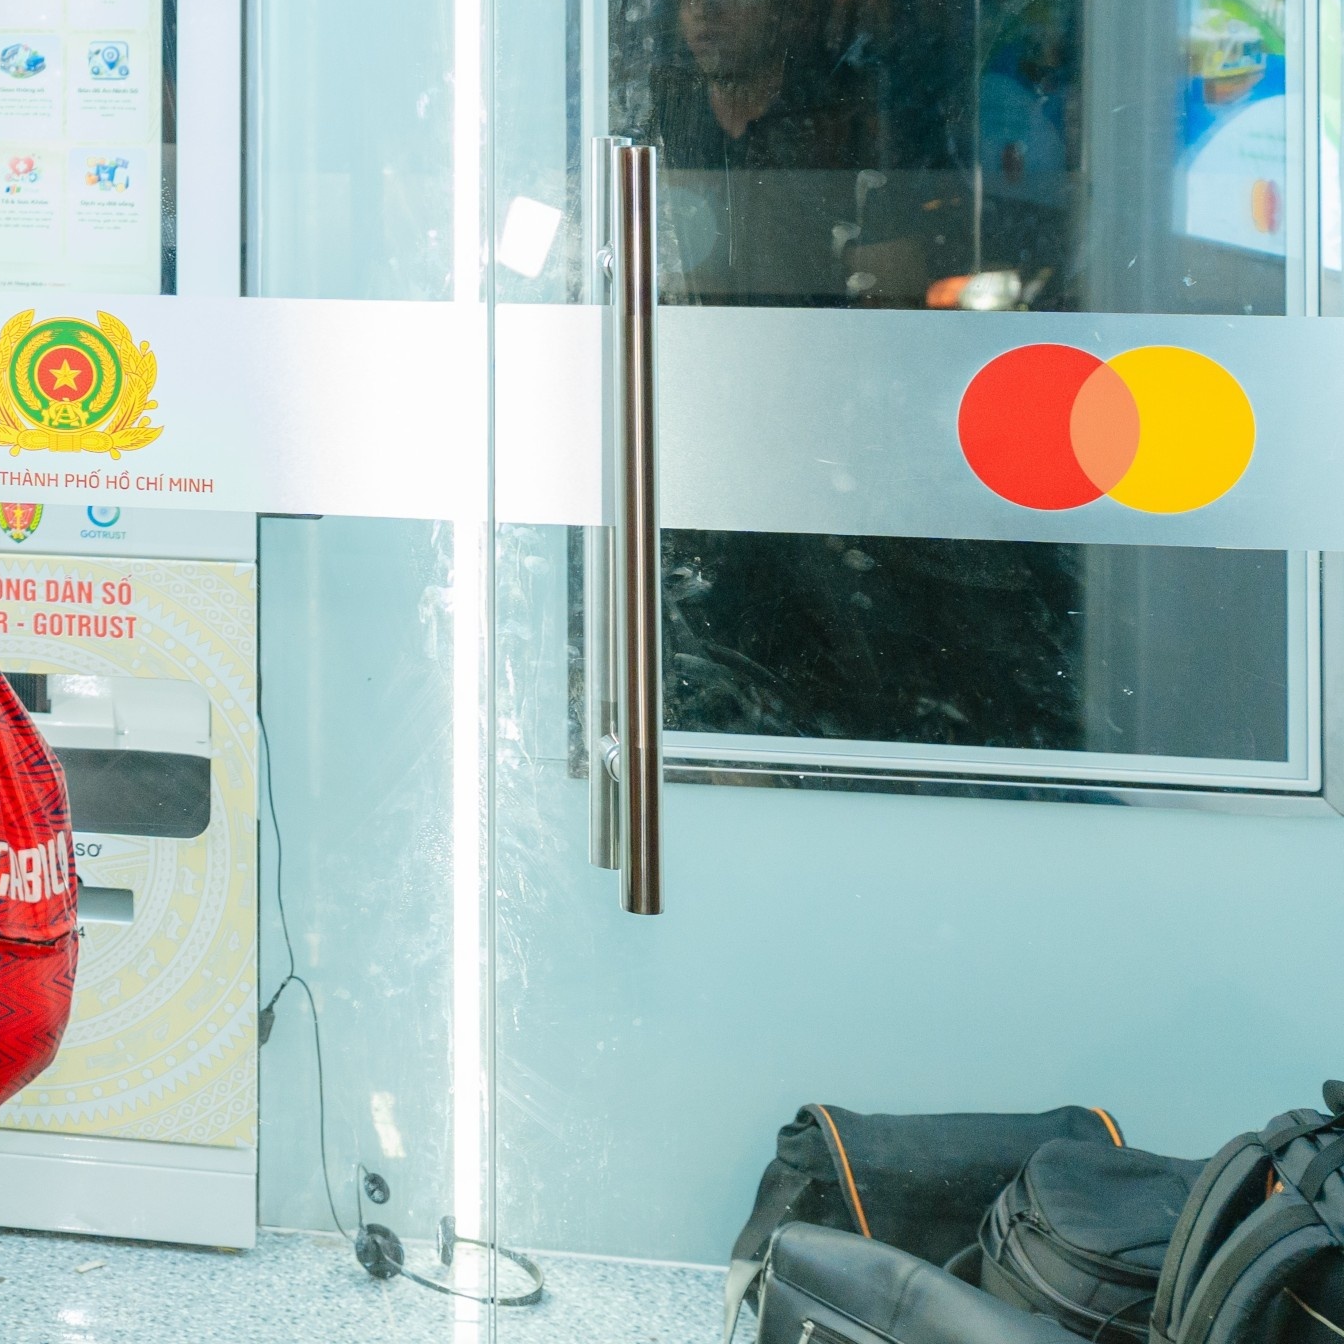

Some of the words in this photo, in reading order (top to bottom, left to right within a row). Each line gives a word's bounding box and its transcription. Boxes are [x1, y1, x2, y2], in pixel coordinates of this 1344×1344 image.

[0, 469, 59, 487] THÀNH
[64, 468, 100, 489] PHỐ
[106, 470, 130, 490] HỒ
[136, 473, 164, 491] CHÍ
[169, 478, 214, 493] MINH
[80, 529, 126, 540] GOTRUST
[45, 575, 93, 604] DÂN
[102, 574, 133, 606] SỐ
[33, 613, 137, 639] GOTRUST
